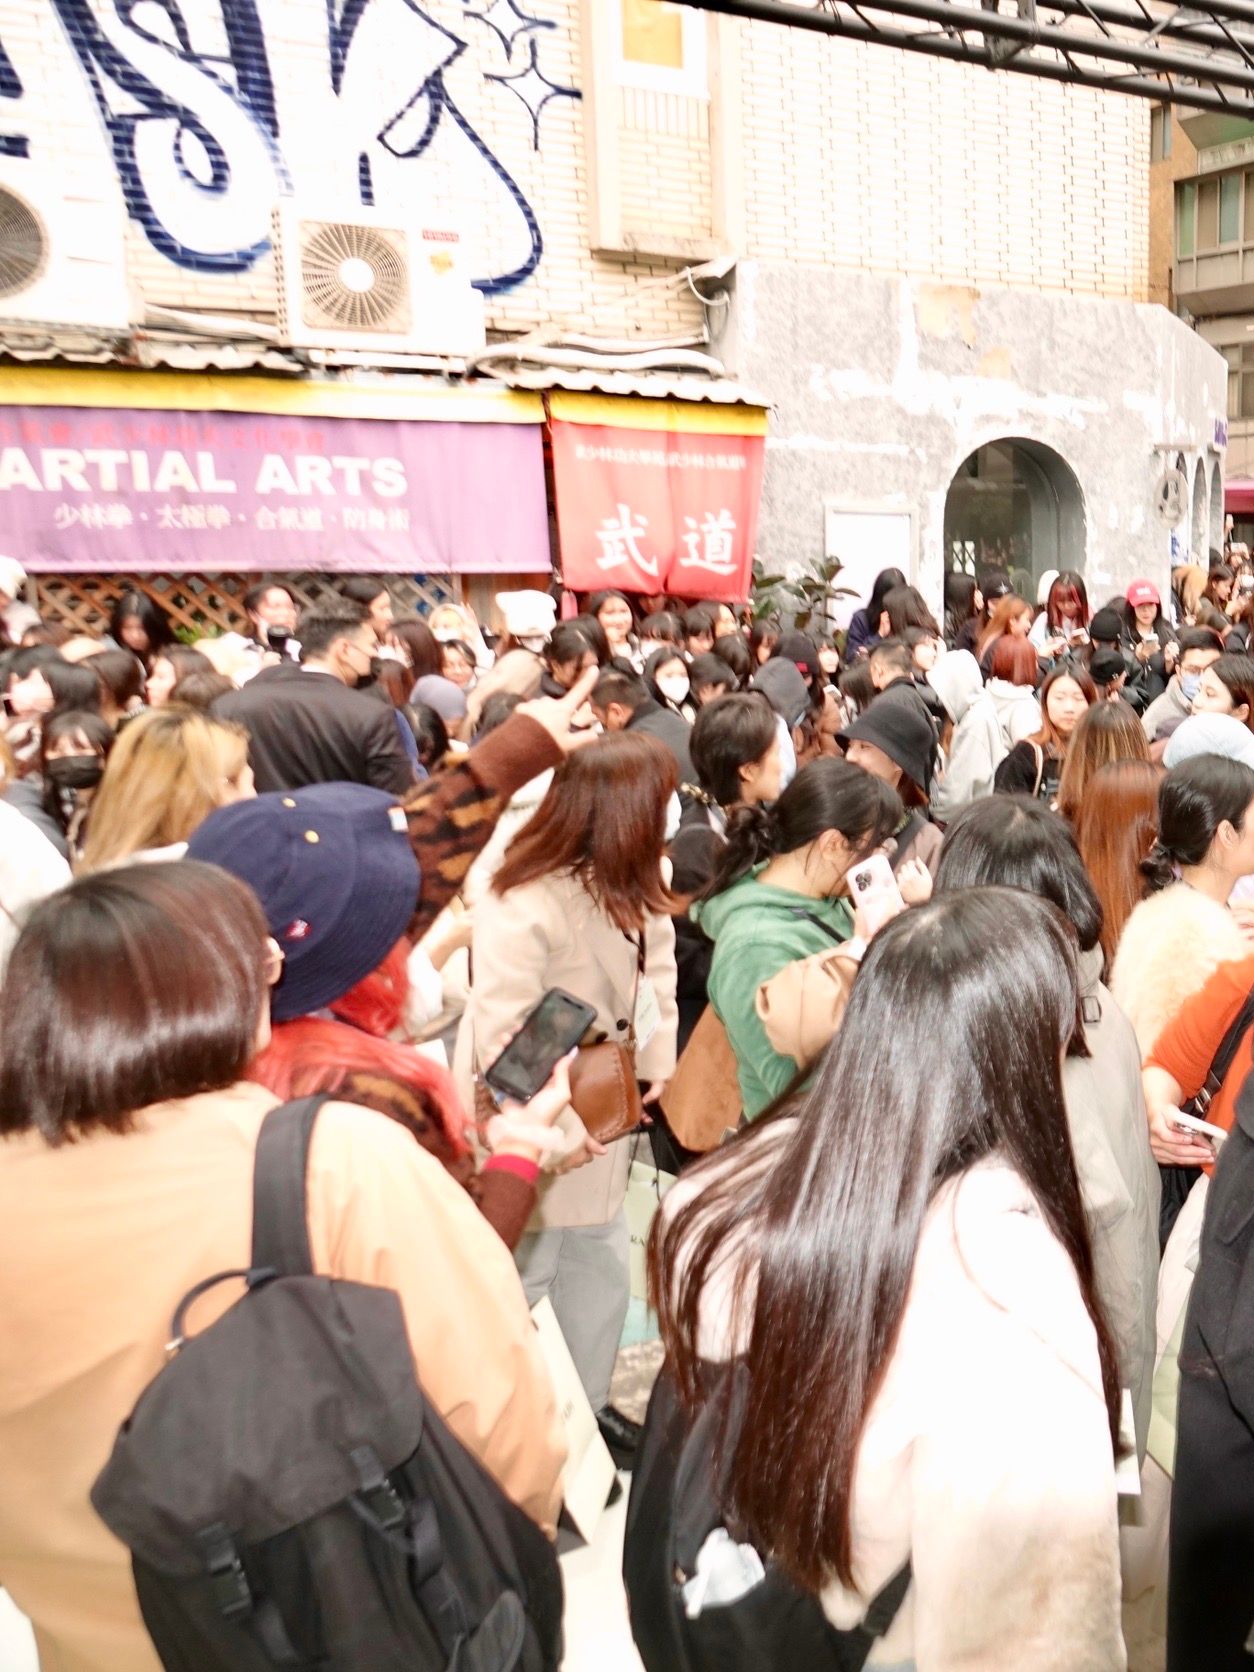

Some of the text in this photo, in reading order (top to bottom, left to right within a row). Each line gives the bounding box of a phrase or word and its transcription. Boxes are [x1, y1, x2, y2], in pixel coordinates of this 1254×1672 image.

[0, 447, 408, 497] ARTIAL ARTS
[595, 502, 738, 576] 武道
